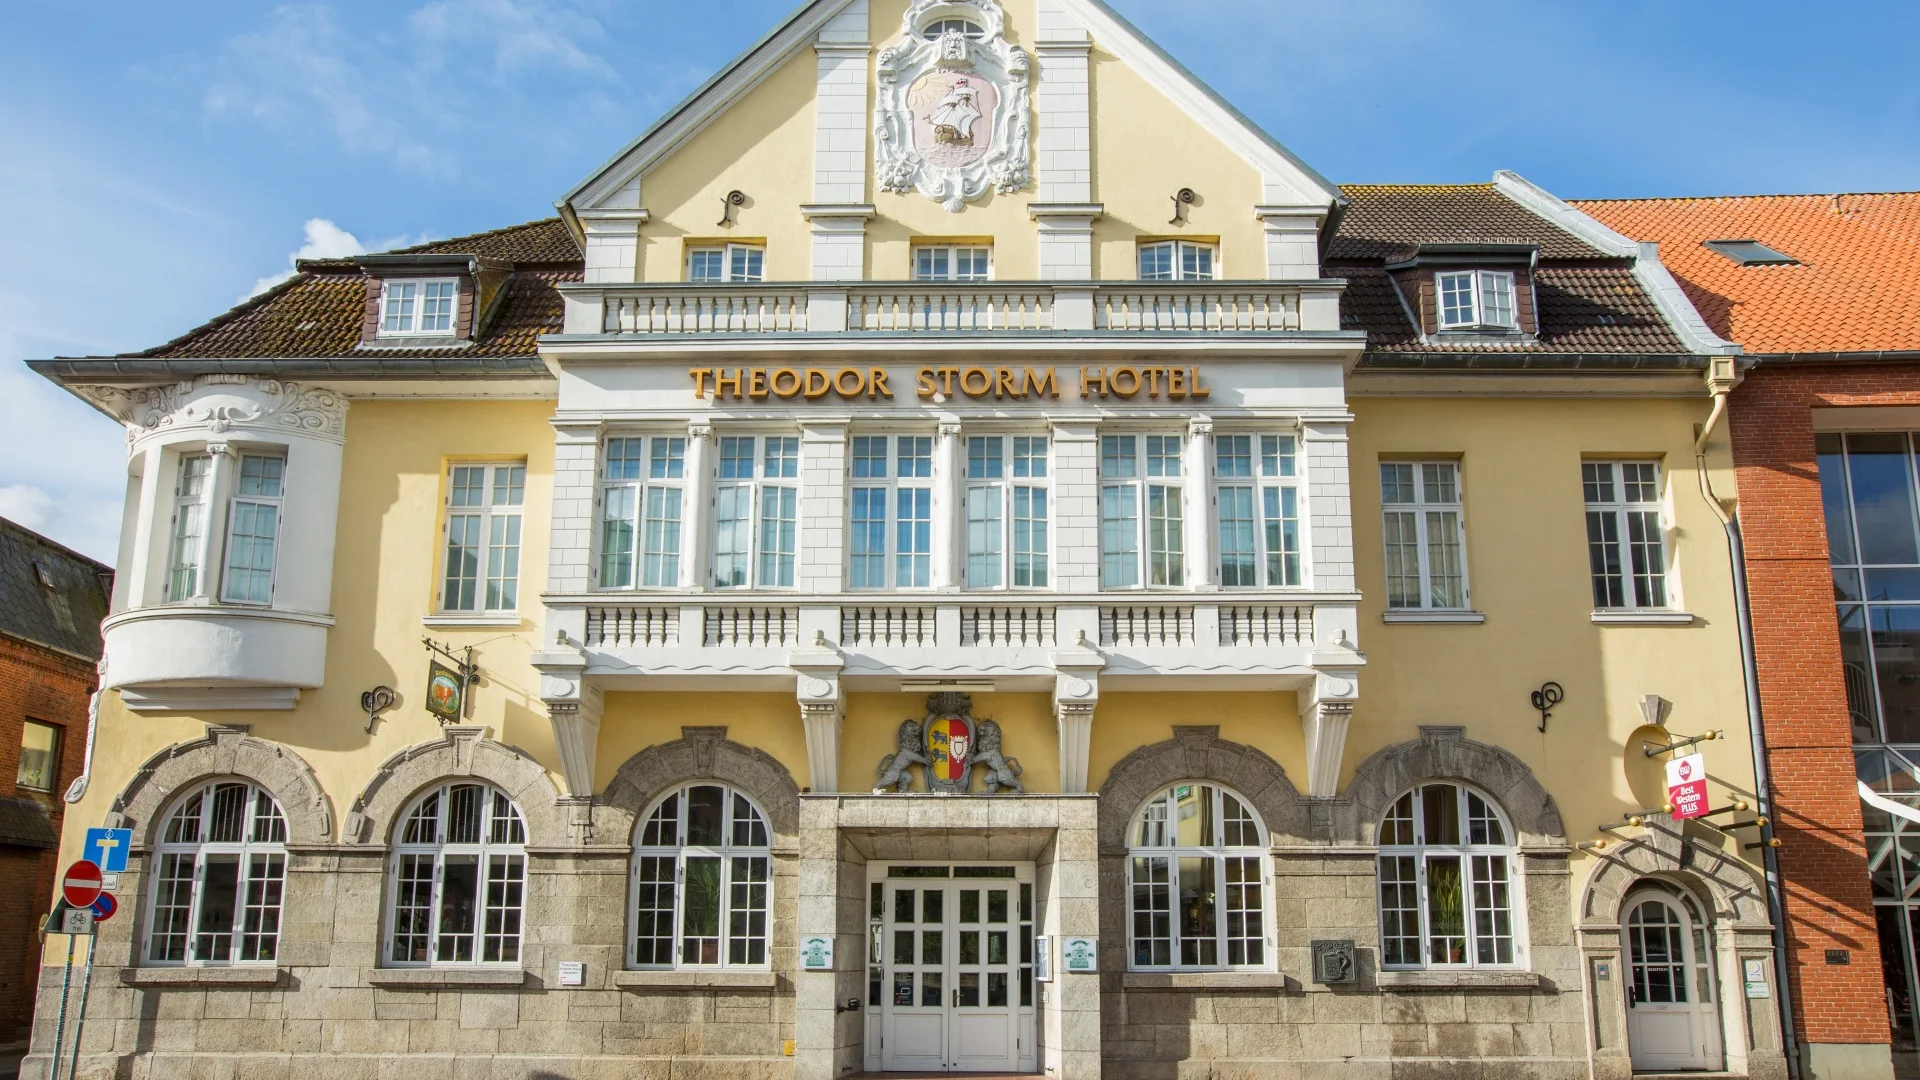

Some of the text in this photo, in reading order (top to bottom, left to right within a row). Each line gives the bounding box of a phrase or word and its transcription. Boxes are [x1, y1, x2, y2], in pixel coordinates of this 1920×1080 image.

[689, 364, 1212, 399] THEODOR STORM HOTEL
[1680, 766, 1690, 776] BW
[1680, 786, 1695, 795] Best
[1676, 793, 1701, 804] Western
